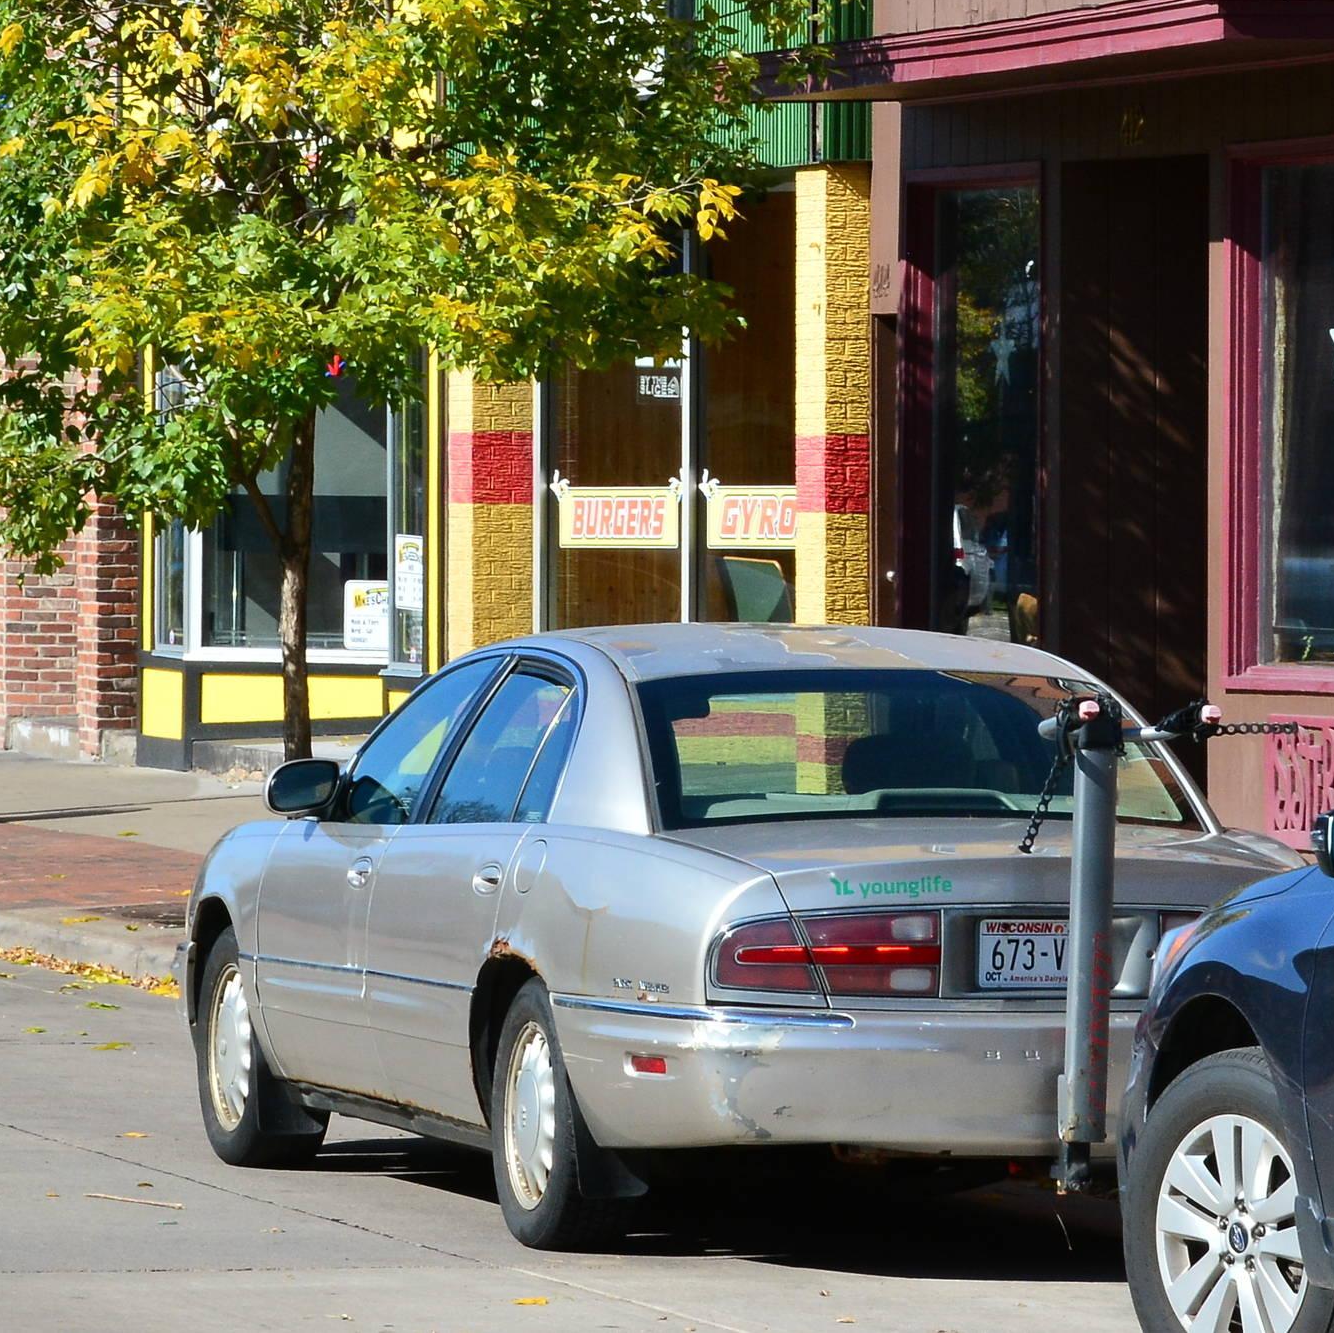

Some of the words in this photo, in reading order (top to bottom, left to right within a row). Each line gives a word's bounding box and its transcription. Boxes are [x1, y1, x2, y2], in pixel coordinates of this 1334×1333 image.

[571, 497, 667, 538] BURGERS
[858, 875, 953, 899] younglife
[986, 921, 1053, 934] WISCONSIN
[985, 971, 1002, 981] OCT
